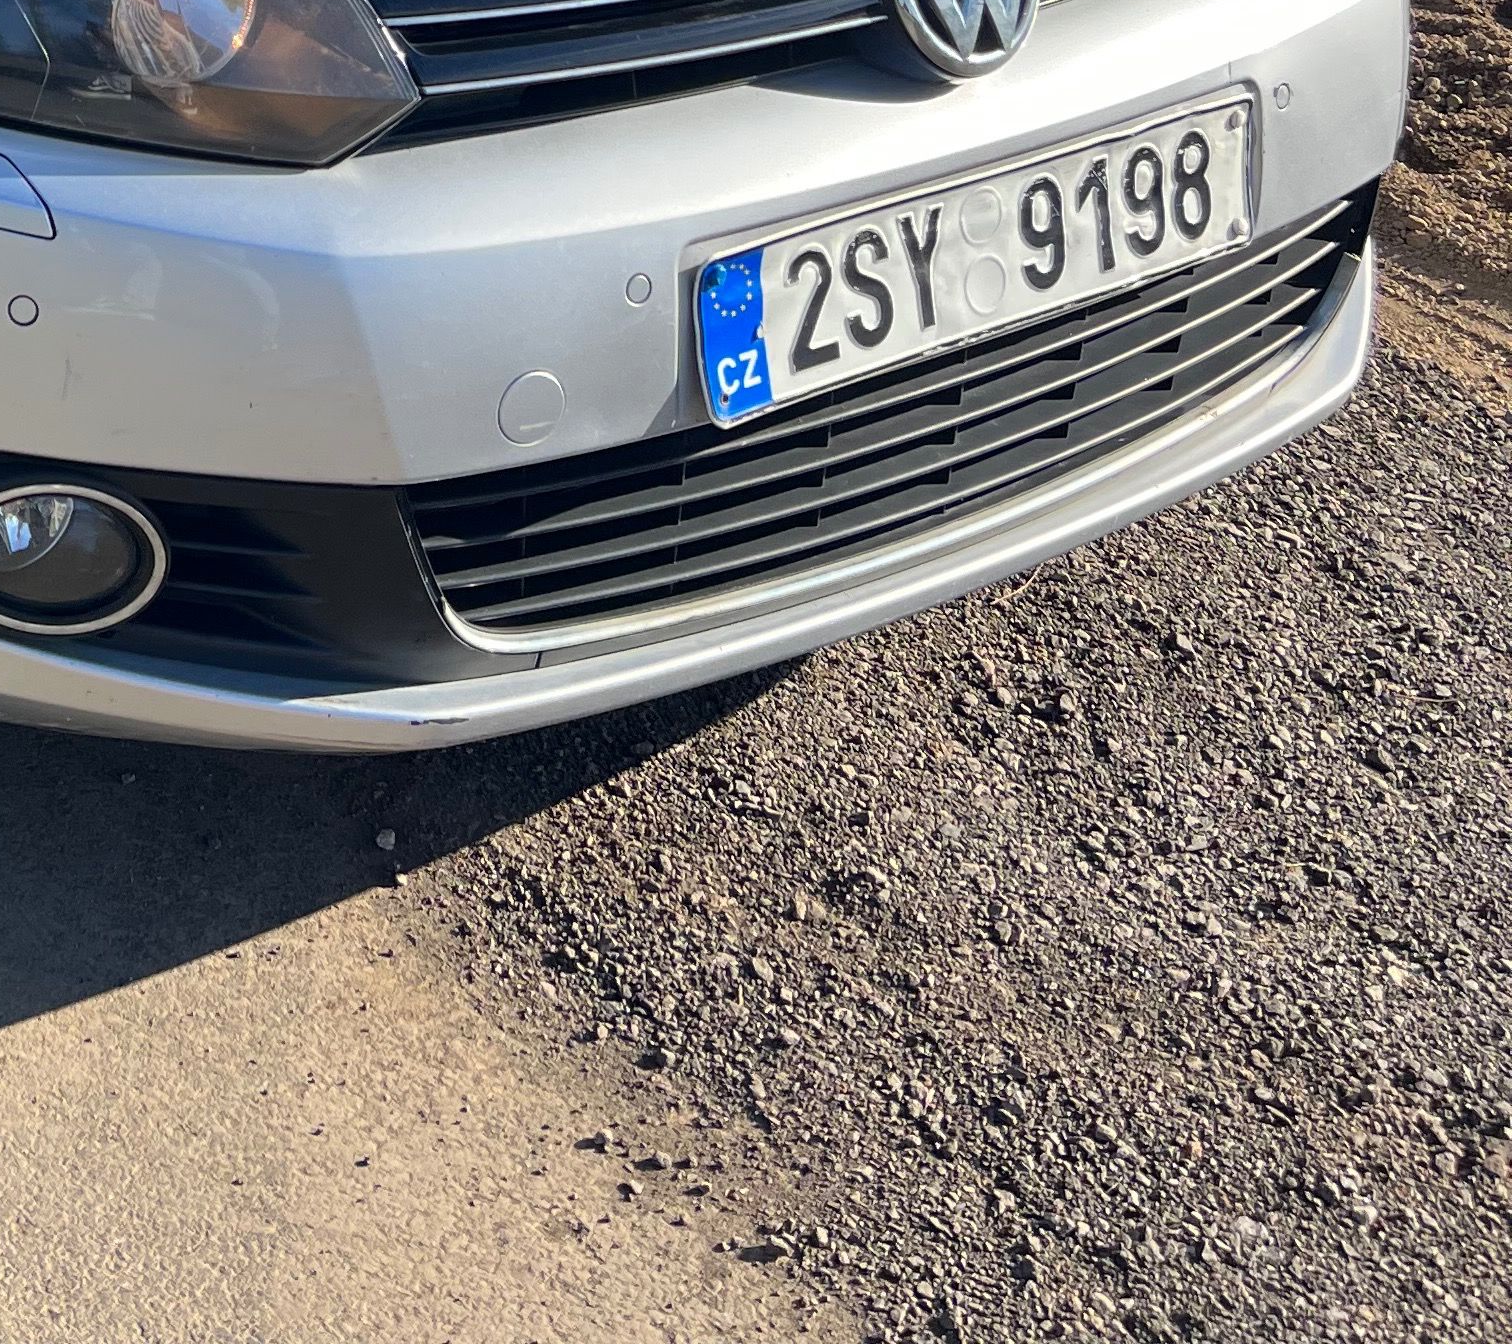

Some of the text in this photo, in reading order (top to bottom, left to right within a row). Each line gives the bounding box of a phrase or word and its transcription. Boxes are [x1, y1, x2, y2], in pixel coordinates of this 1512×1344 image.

[784, 128, 1210, 374] 2SY 9198
[716, 348, 762, 396] CZ
